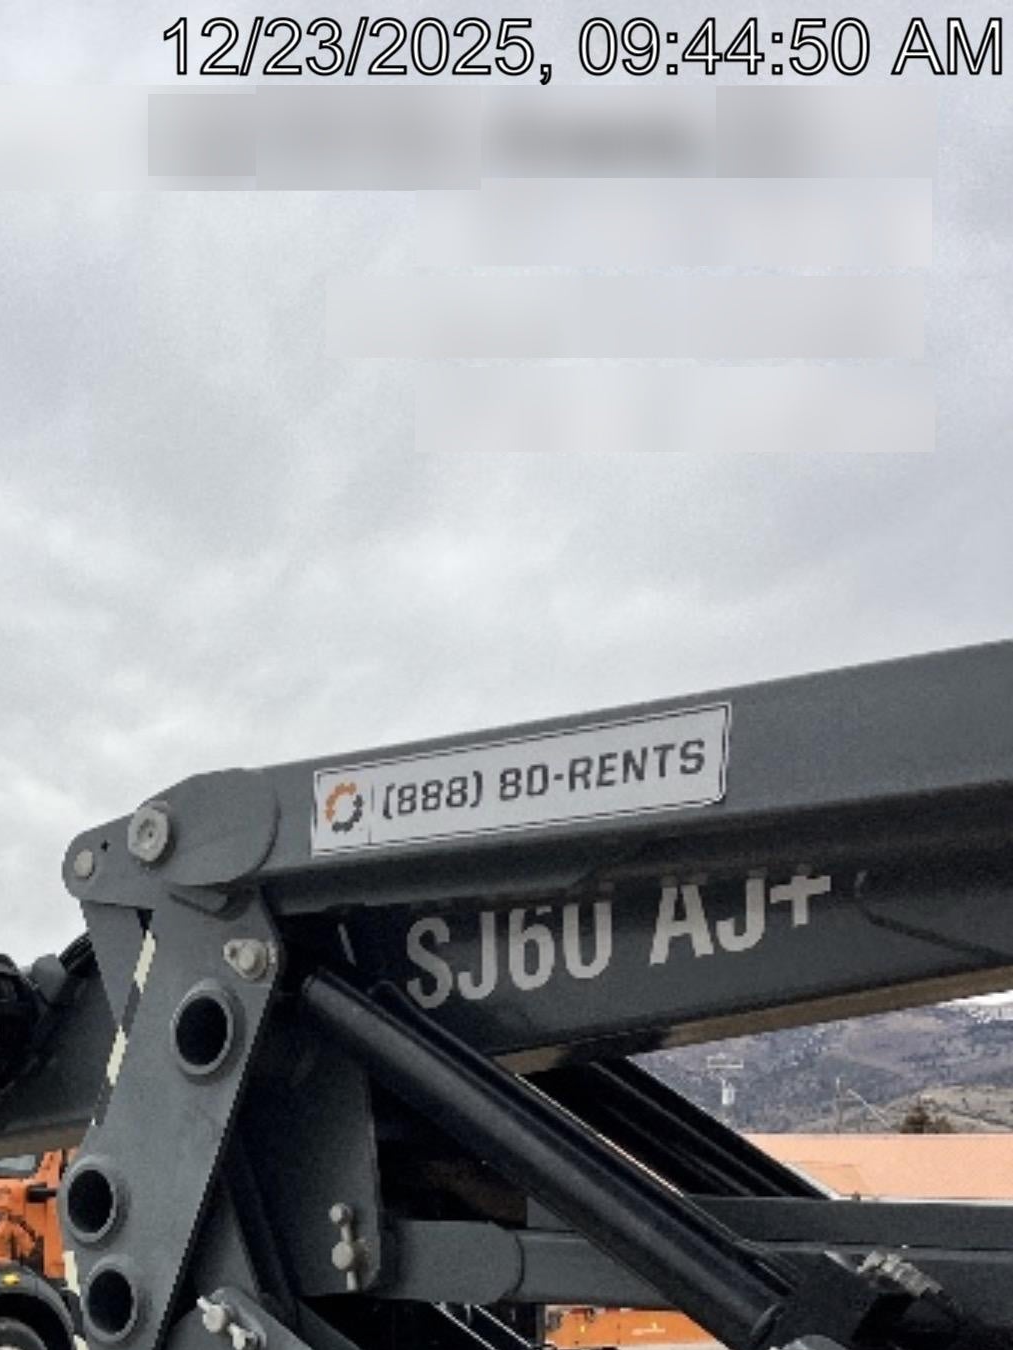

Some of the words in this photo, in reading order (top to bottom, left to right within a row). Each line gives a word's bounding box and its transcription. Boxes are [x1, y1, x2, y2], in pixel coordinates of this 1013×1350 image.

[381, 769, 484, 821] (888)
[499, 738, 707, 802] 80-RENTS
[405, 900, 614, 1010] SJ60
[648, 873, 832, 967] AJ+
